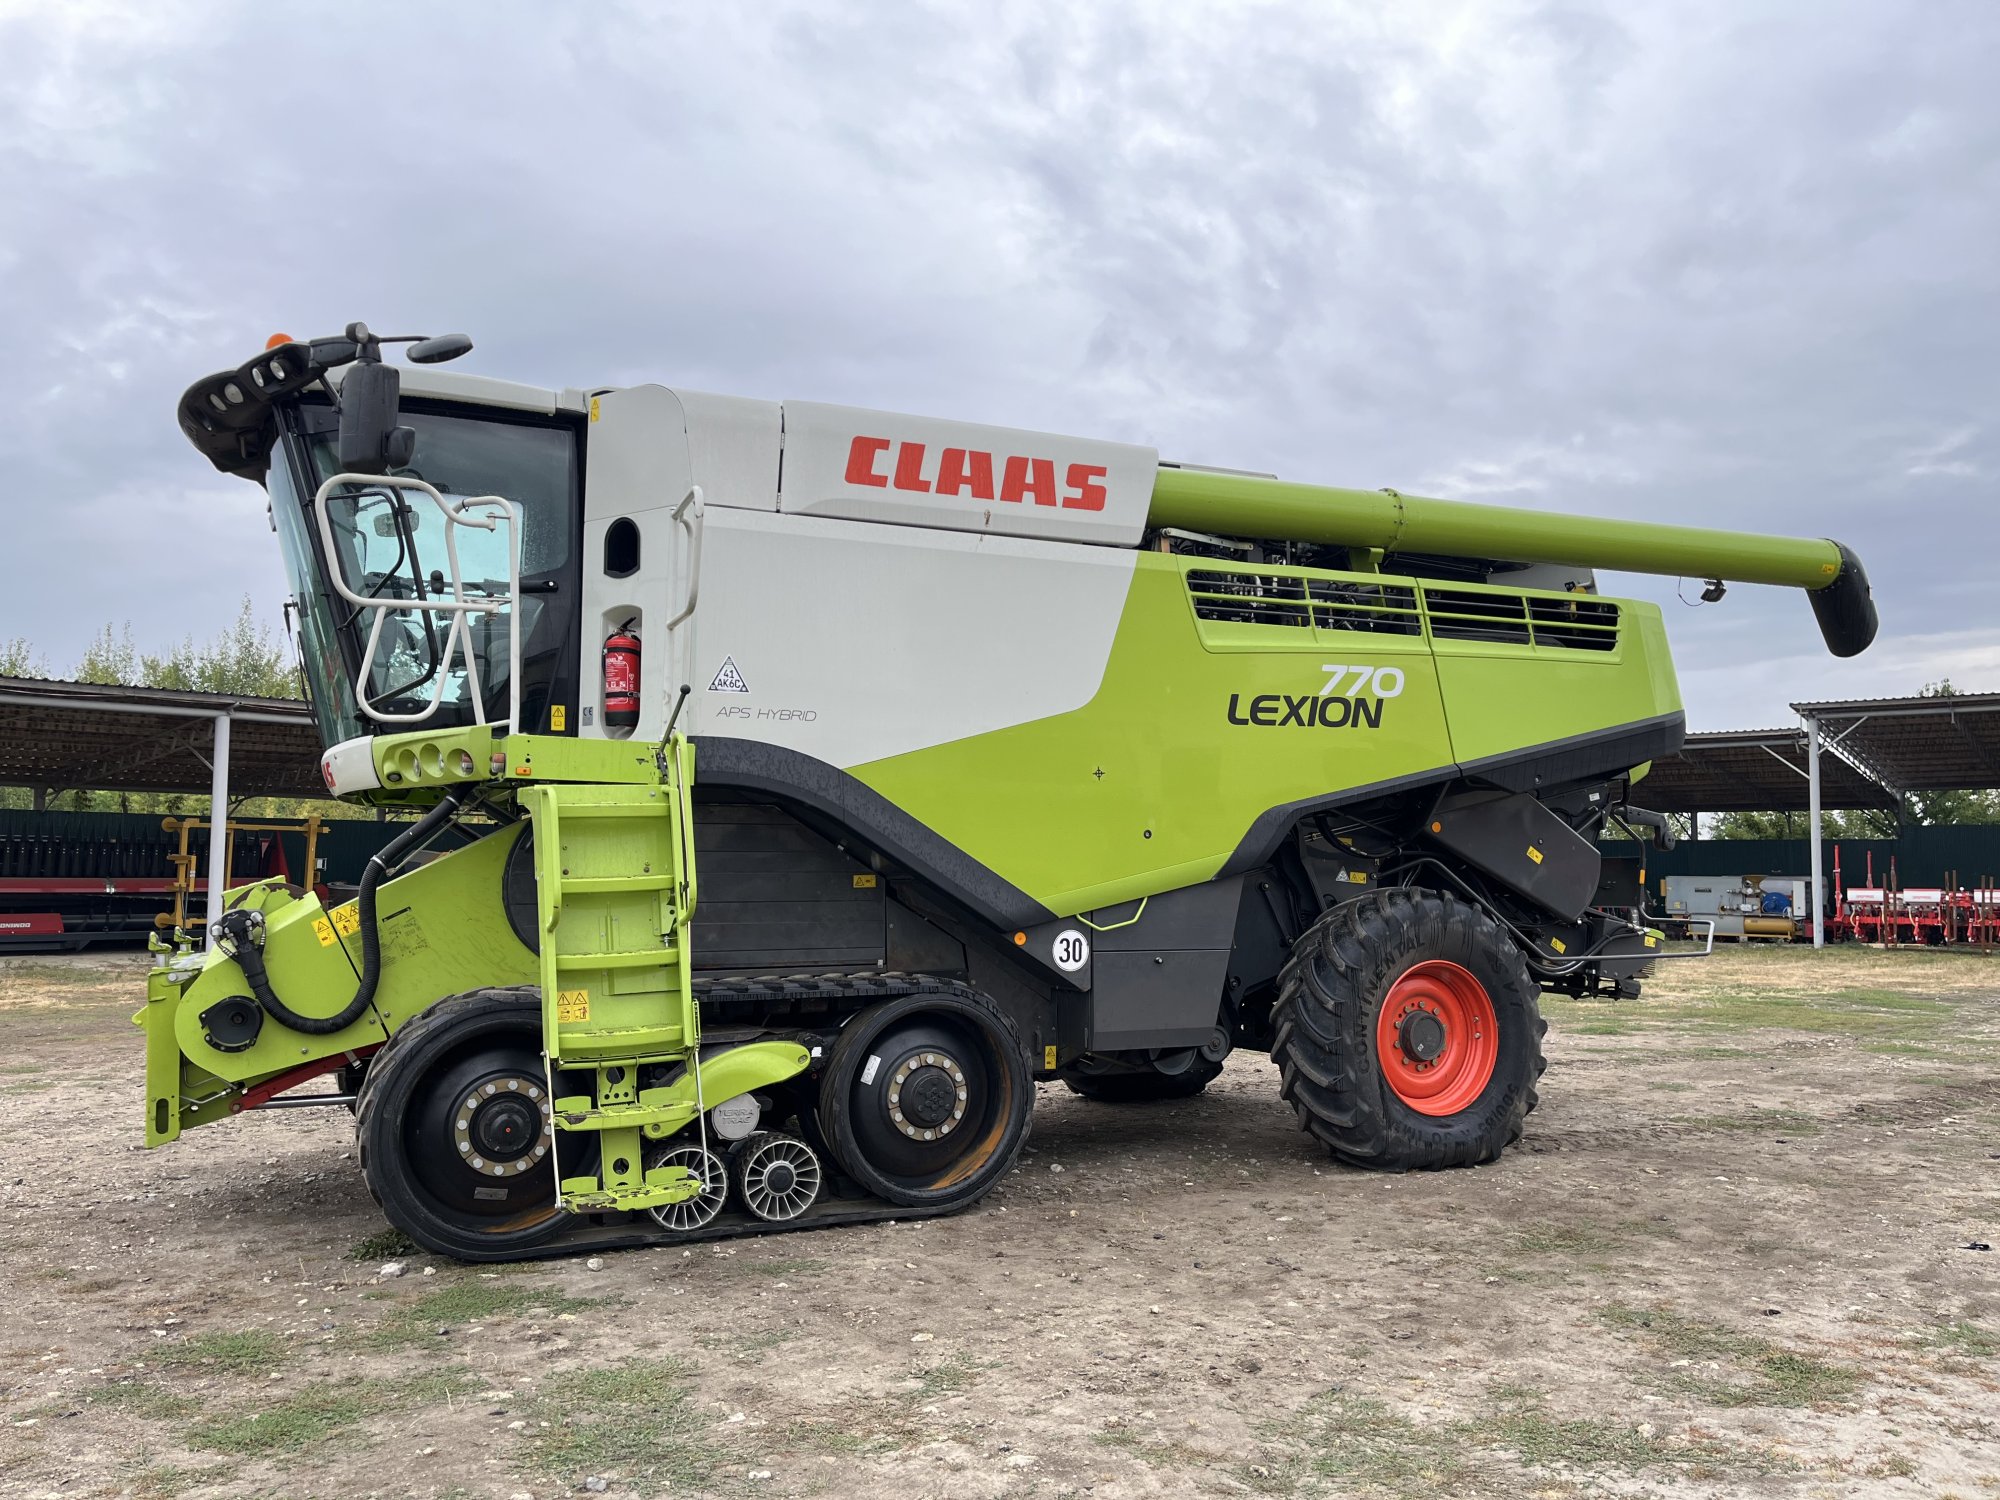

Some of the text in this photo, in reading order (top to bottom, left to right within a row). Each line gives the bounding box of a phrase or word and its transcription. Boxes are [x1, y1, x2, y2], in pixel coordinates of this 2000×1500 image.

[844, 435, 1108, 512] CLAAS
[723, 669, 735, 679] 41
[1319, 664, 1405, 698] 770
[716, 706, 817, 722] APS HYBRID
[1227, 694, 1385, 729] LEXION
[1059, 938, 1083, 963] 30
[719, 1108, 754, 1117] TERRA
[722, 1116, 752, 1125] TRAC
